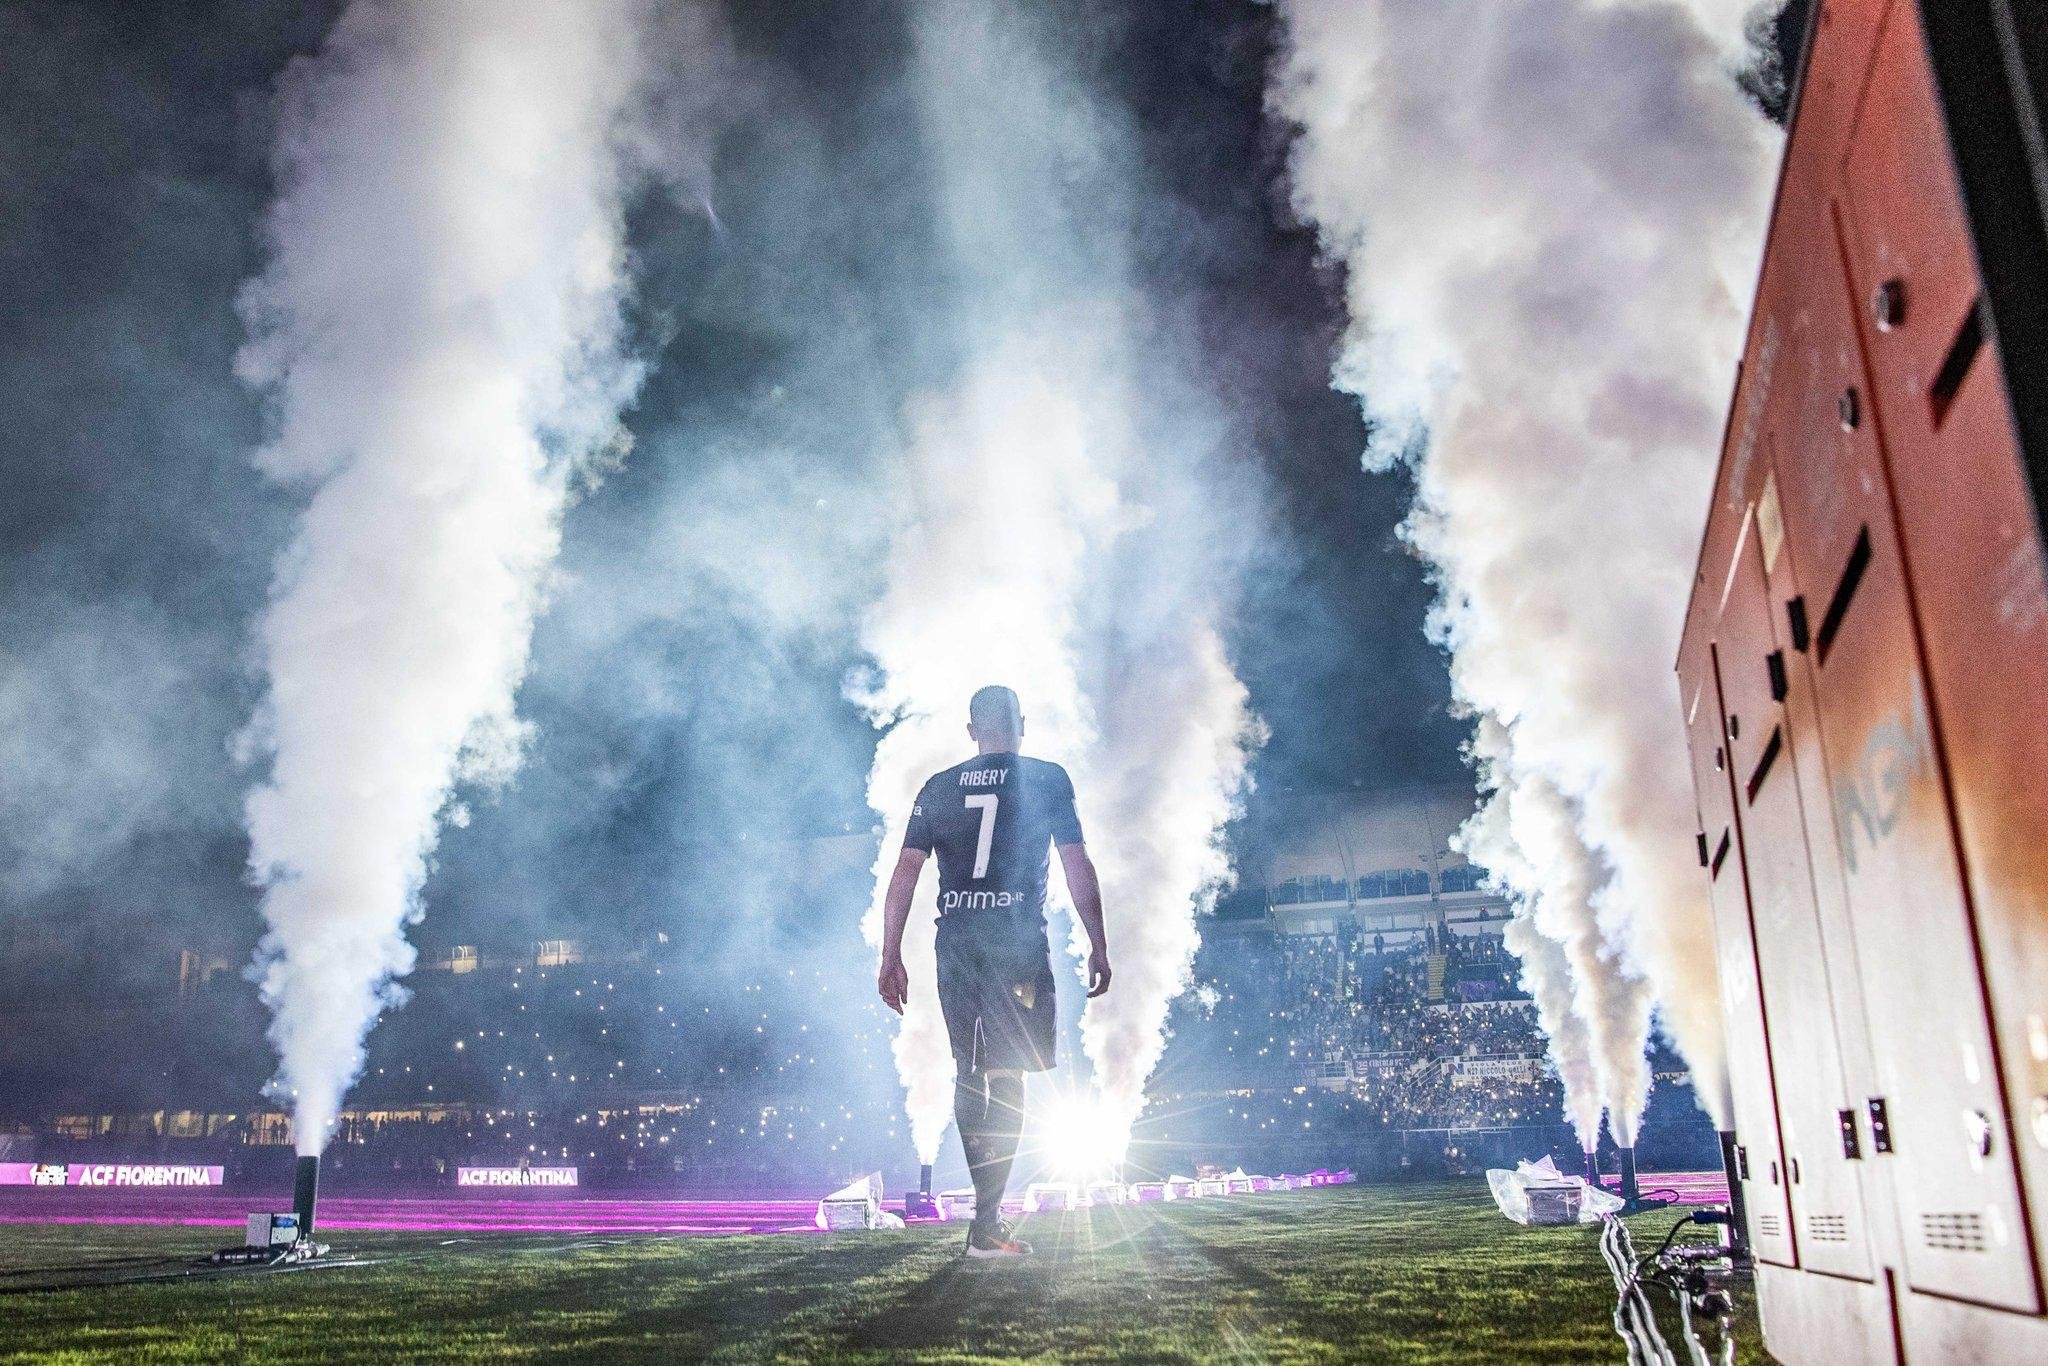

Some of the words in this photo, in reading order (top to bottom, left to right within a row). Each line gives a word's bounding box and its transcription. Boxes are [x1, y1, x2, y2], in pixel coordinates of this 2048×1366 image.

[964, 794, 999, 879] 7
[79, 1166, 117, 1186] ACF
[116, 1166, 210, 1186] FIORENTINA
[460, 1170, 488, 1185] ACF
